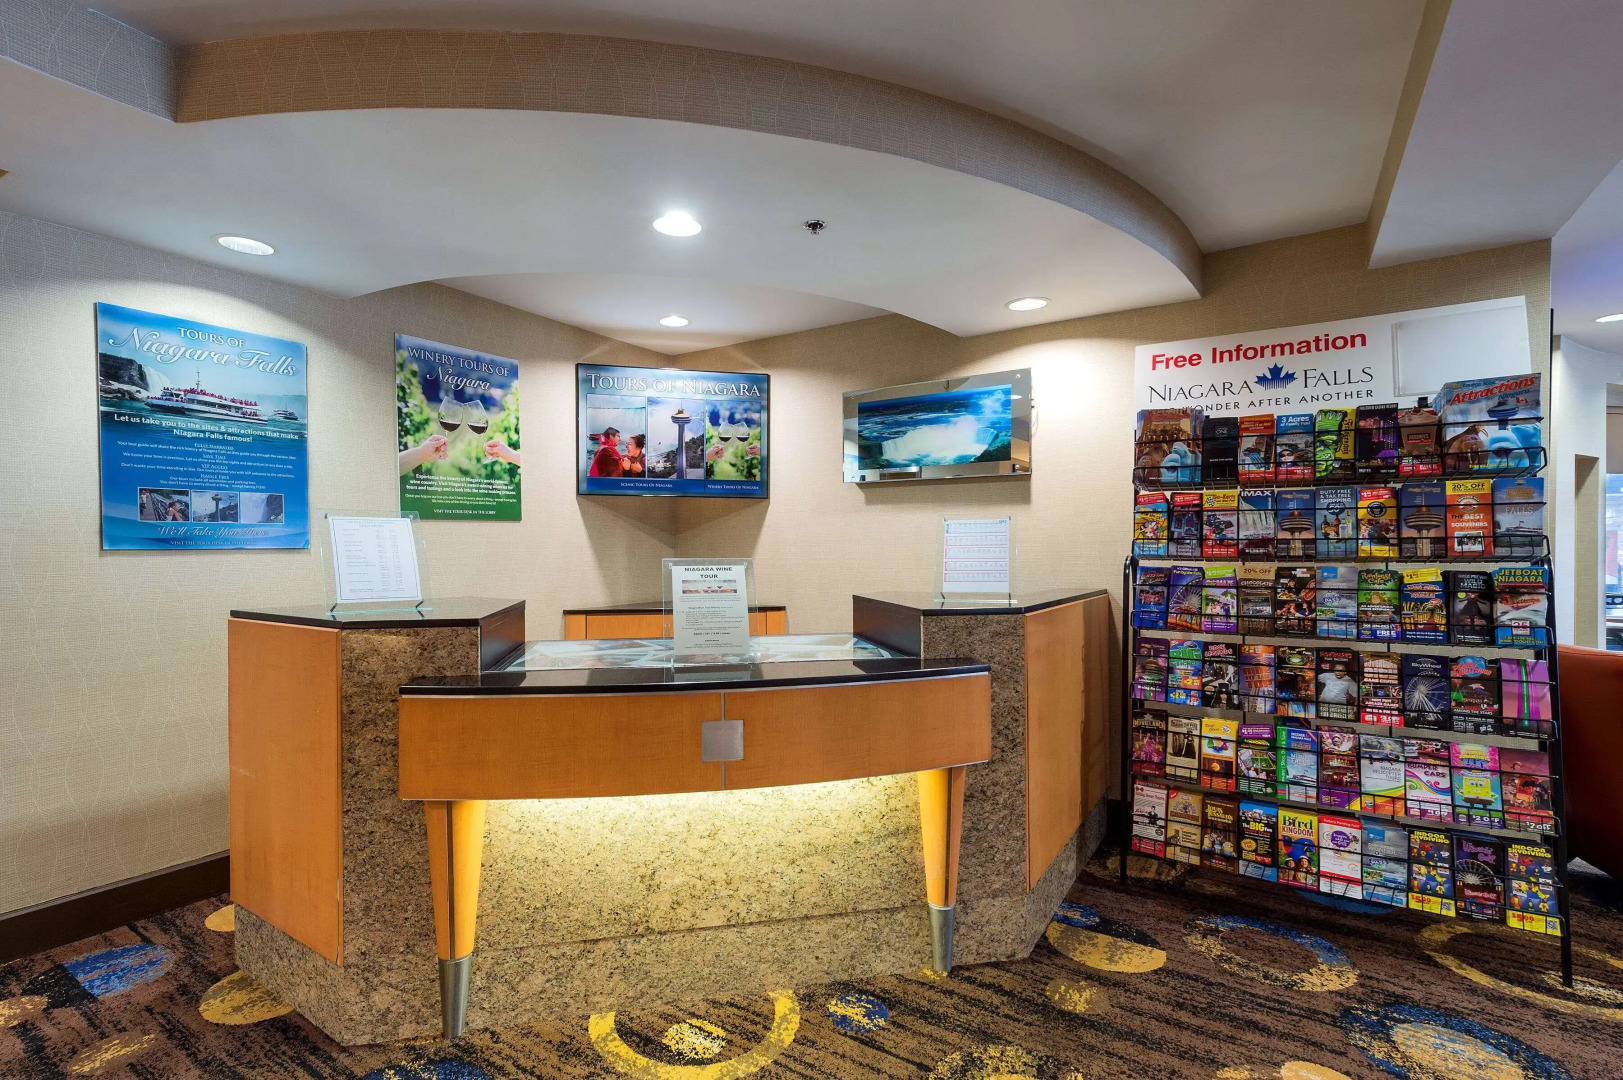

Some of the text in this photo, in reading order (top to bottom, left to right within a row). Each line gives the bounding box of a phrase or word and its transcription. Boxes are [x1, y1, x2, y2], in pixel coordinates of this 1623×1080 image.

[177, 326, 246, 349] TOURS OF
[108, 327, 300, 377] Niagara Falls
[1152, 332, 1367, 371] Free Information
[407, 346, 510, 377] WINERY TOURS OF
[426, 366, 491, 391] Niagara
[586, 372, 762, 397] TOURS OF NIAGARA
[1148, 366, 1374, 403] NIAGARA FALLS
[1449, 376, 1536, 406] Attractions
[1498, 388, 1531, 400] Niagara
[1248, 397, 1291, 409] AFTER
[1299, 389, 1374, 404] ANOTHER
[114, 413, 129, 422] Let
[142, 416, 161, 426] take
[161, 419, 177, 429] you
[178, 420, 187, 428] to
[188, 421, 201, 430] the
[201, 423, 219, 432] sites
[220, 424, 226, 432] &
[227, 425, 266, 437] attractions
[265, 428, 280, 438] that
[280, 429, 299, 440] make
[173, 428, 254, 443] Niagara Falls famous!
[187, 526, 215, 536] Take
[1169, 648, 1203, 661] BIG
[1411, 661, 1442, 669] SkyWheel
[1372, 769, 1402, 777] HELICOPTER
[1407, 762, 1439, 771] BUMPER
[1424, 770, 1447, 778] CARS
[1249, 821, 1265, 831] BIG
[1282, 815, 1314, 830] Bird
[1281, 826, 1314, 838] KINGDOM
[1414, 830, 1445, 839] INDOOR
[1410, 834, 1450, 844] SKYDIVING
[1507, 848, 1552, 858] SKYDIVING
[1511, 844, 1546, 853] INDOOR
